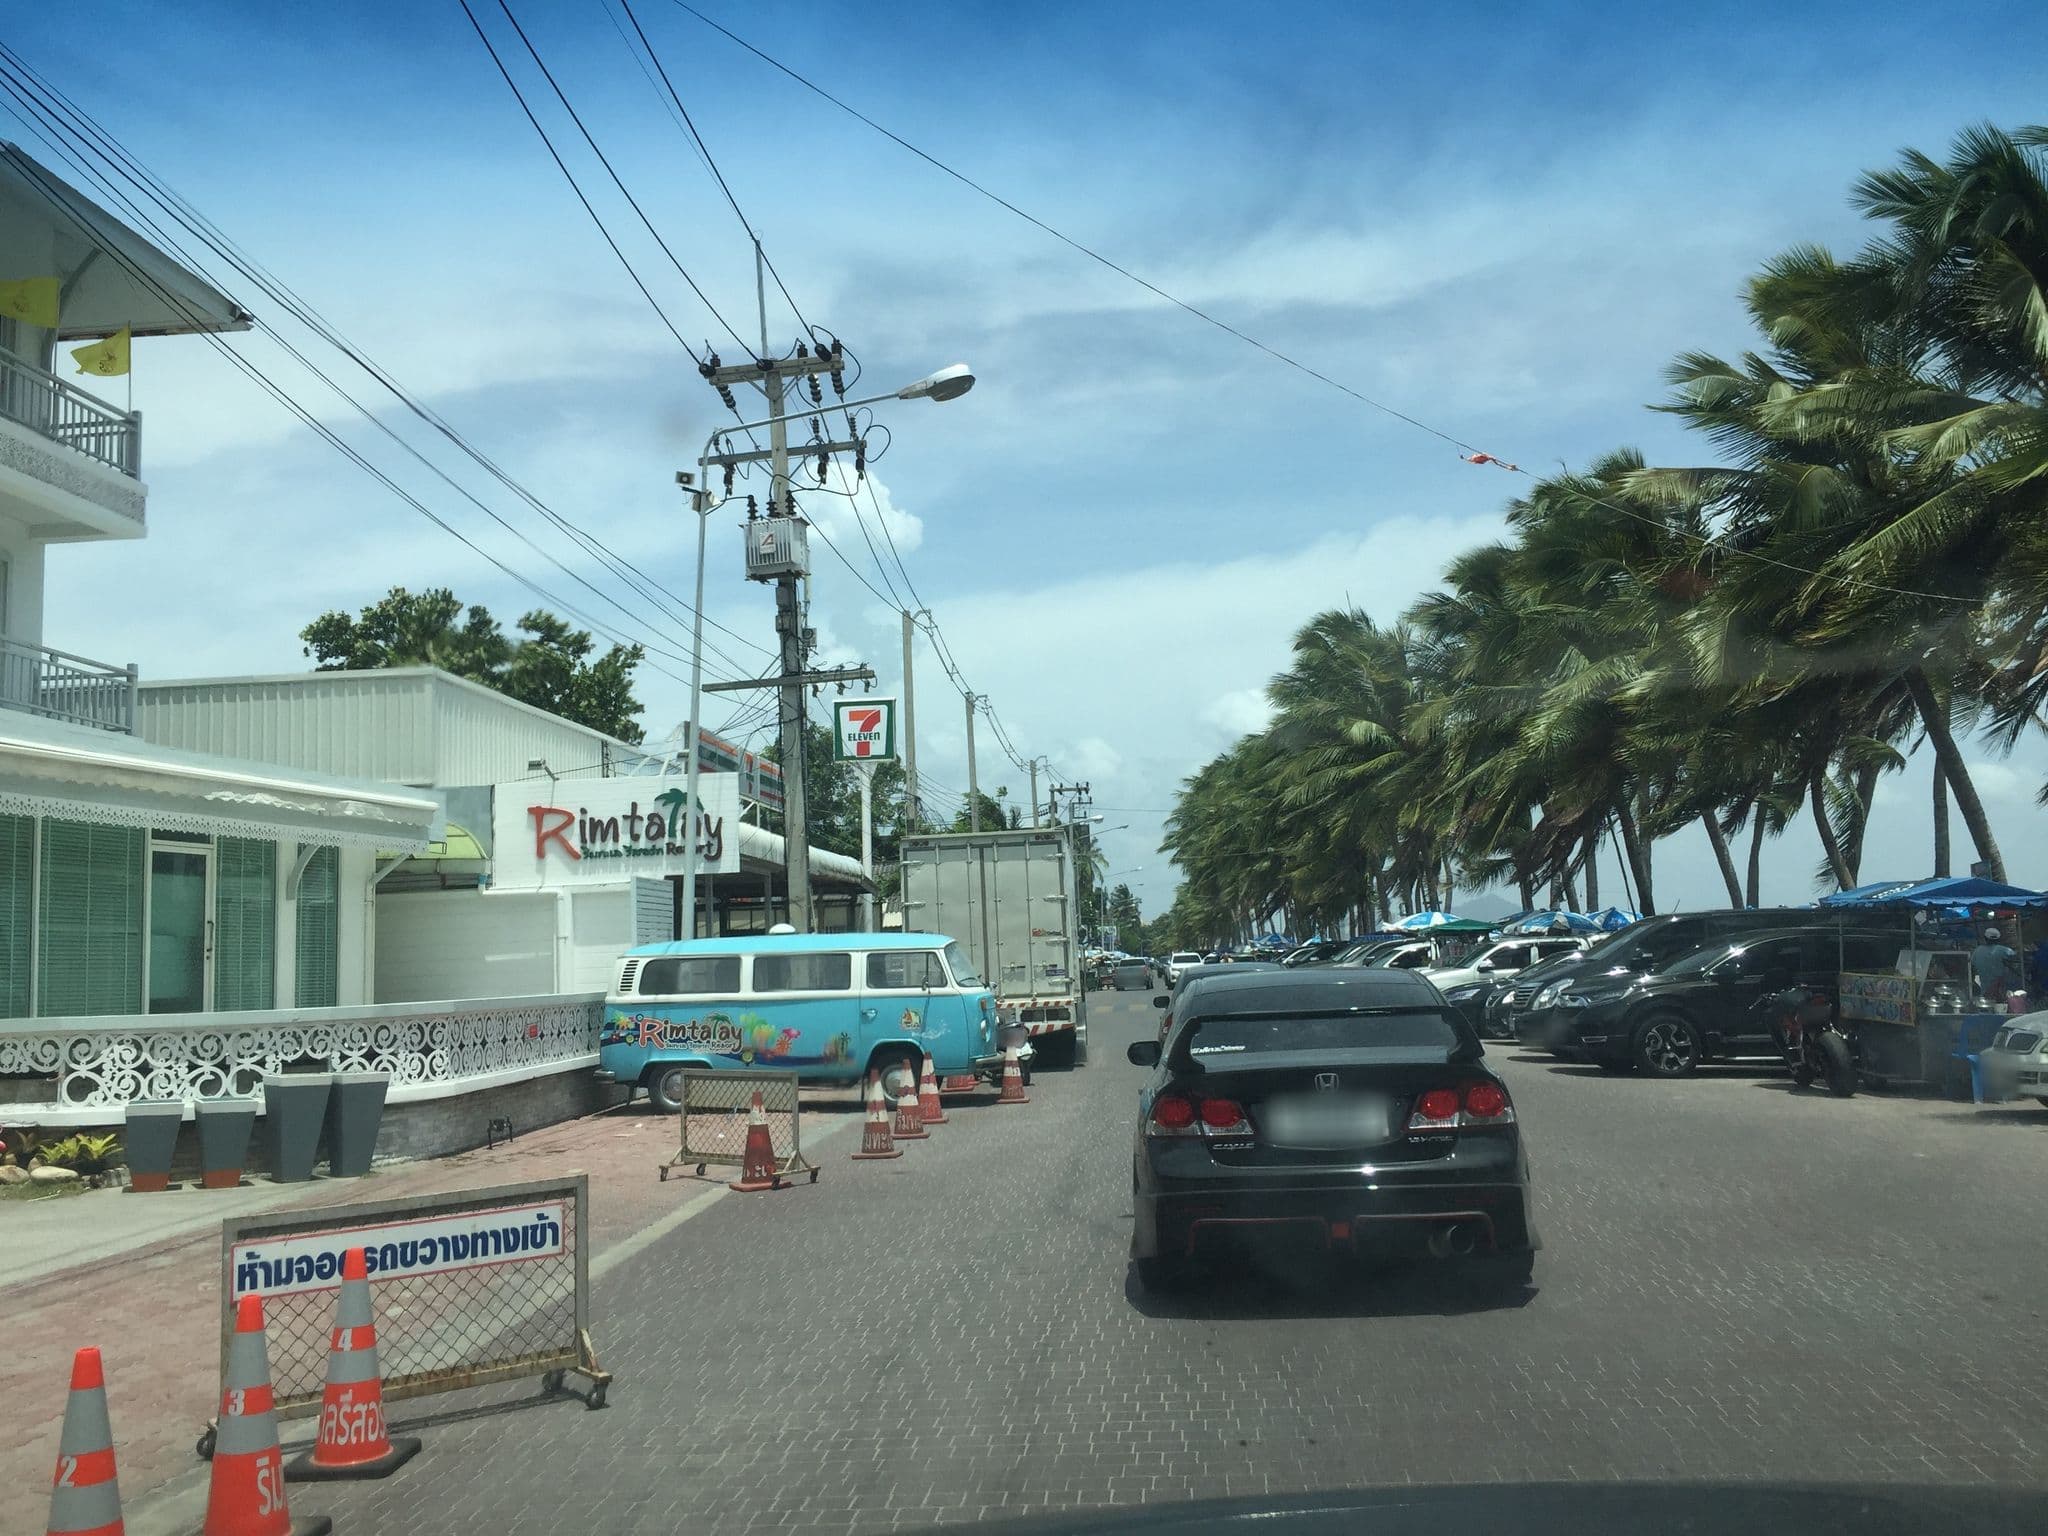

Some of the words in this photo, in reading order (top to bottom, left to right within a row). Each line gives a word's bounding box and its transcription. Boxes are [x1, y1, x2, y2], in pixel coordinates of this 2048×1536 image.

[848, 709, 881, 757] 7
[640, 1013, 743, 1053] Rimtalay
[337, 1328, 353, 1352] 4
[228, 1389, 245, 1417] 3
[60, 1455, 78, 1488] 2
